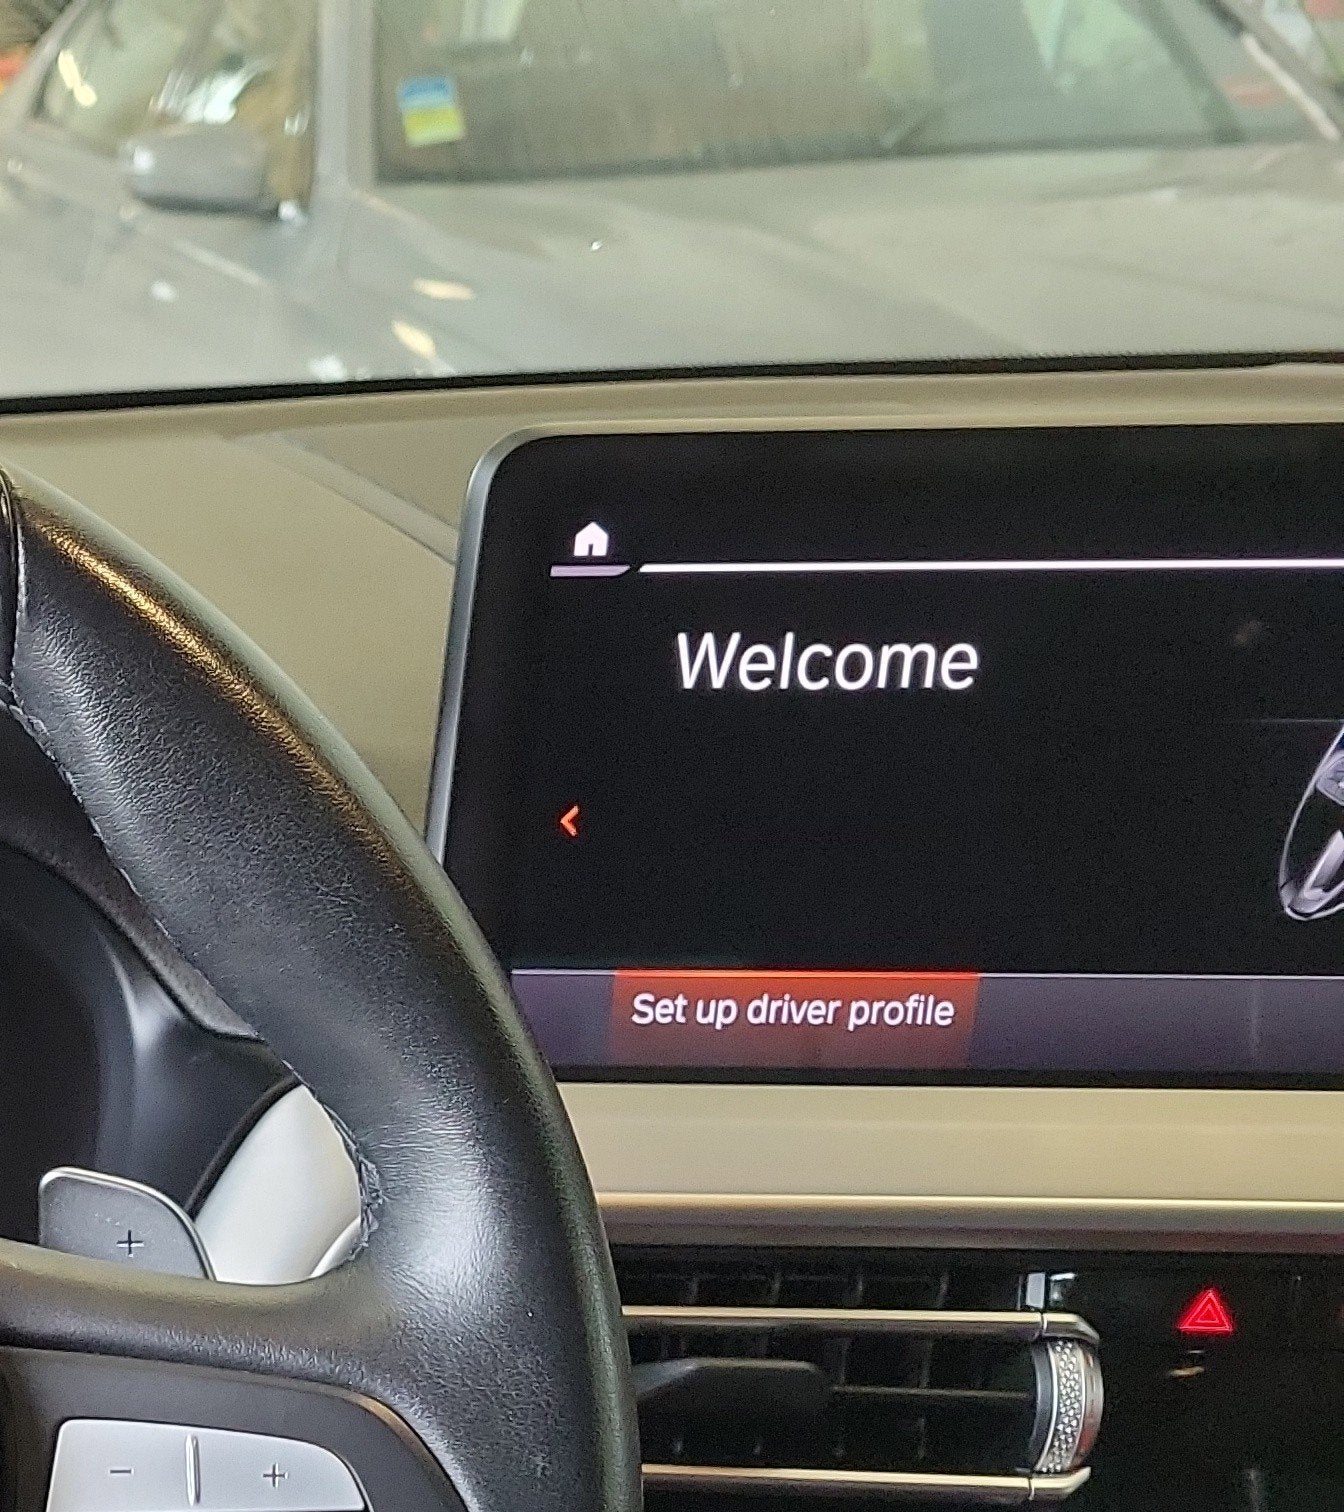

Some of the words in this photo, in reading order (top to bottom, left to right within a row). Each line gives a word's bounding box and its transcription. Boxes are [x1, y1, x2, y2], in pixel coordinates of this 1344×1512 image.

[675, 630, 979, 692] Welcome
[632, 992, 688, 1025] Set
[695, 999, 738, 1030] up
[747, 992, 842, 1026] driver
[847, 994, 956, 1032] profile
